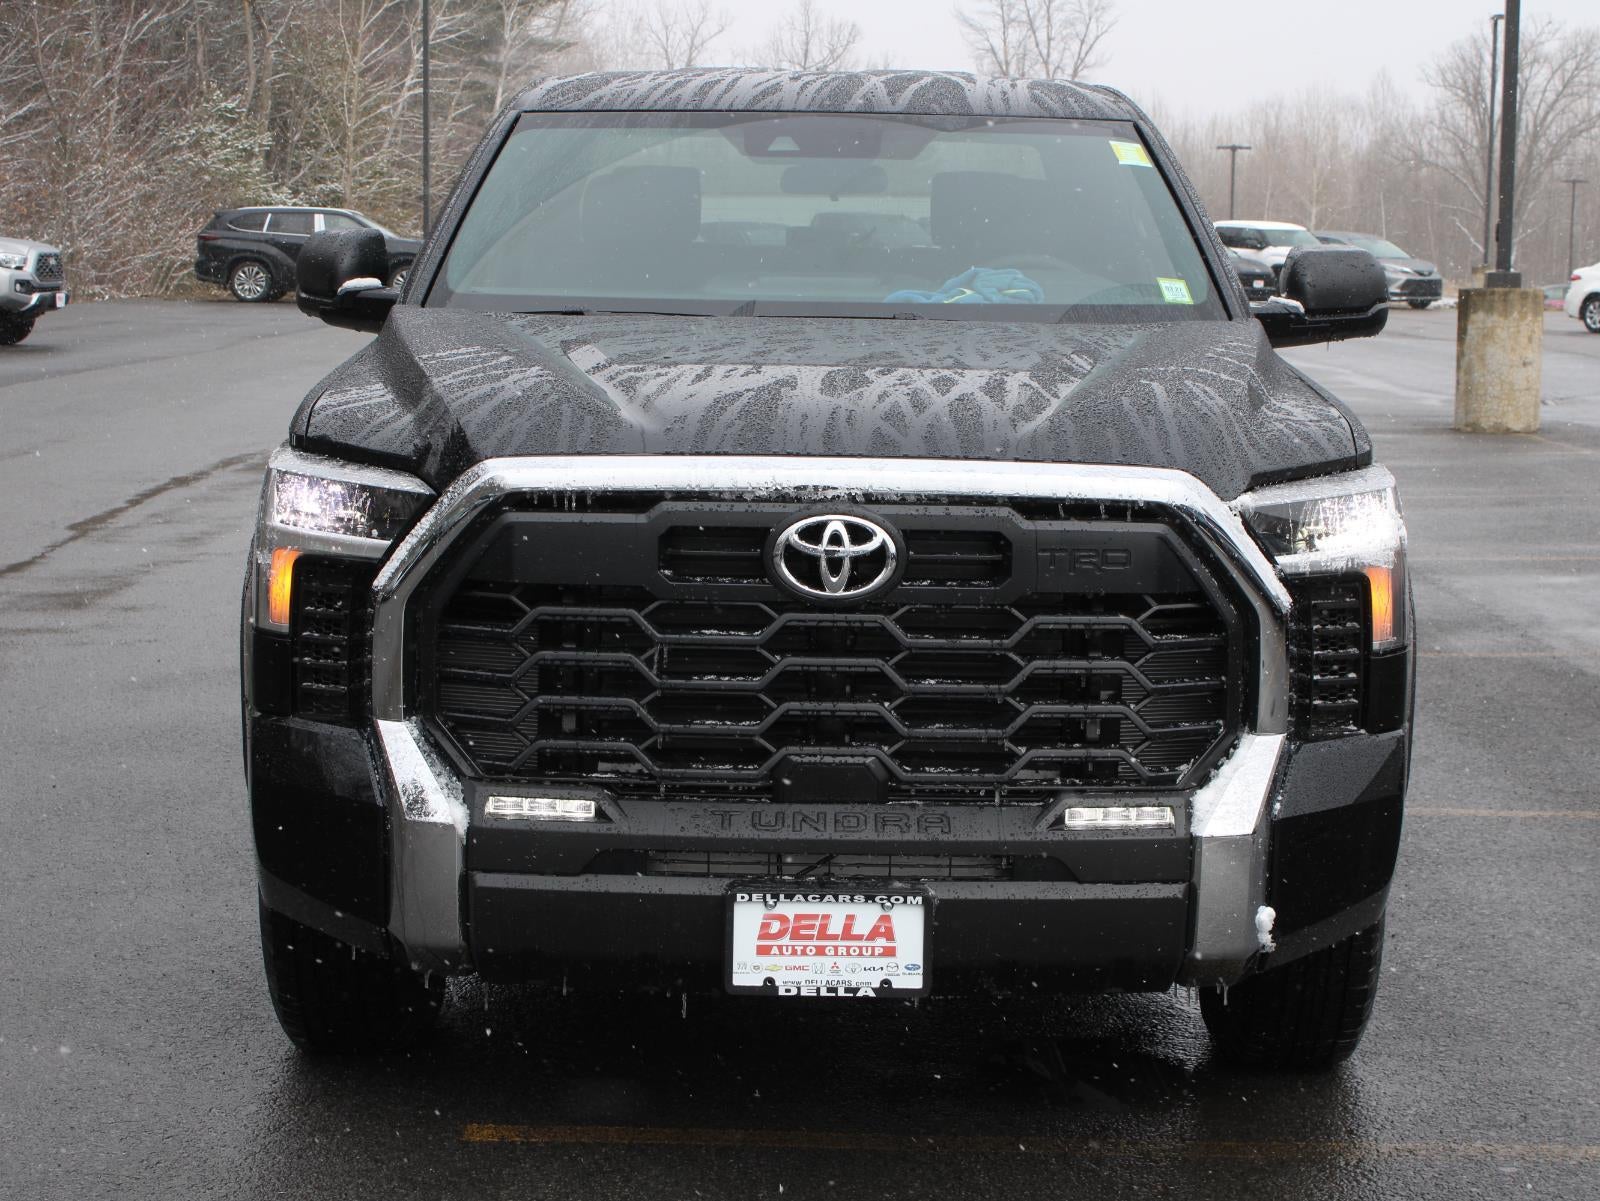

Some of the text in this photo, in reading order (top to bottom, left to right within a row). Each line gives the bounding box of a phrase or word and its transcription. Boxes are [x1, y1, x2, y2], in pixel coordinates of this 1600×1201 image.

[1038, 548, 1131, 575] TRD
[710, 809, 951, 834] TUNDRA
[736, 893, 923, 905] DELLACARS.COM
[757, 913, 896, 942] DELLA
[770, 946, 884, 957] AUTO GROUP
[778, 986, 877, 998] DELLA
